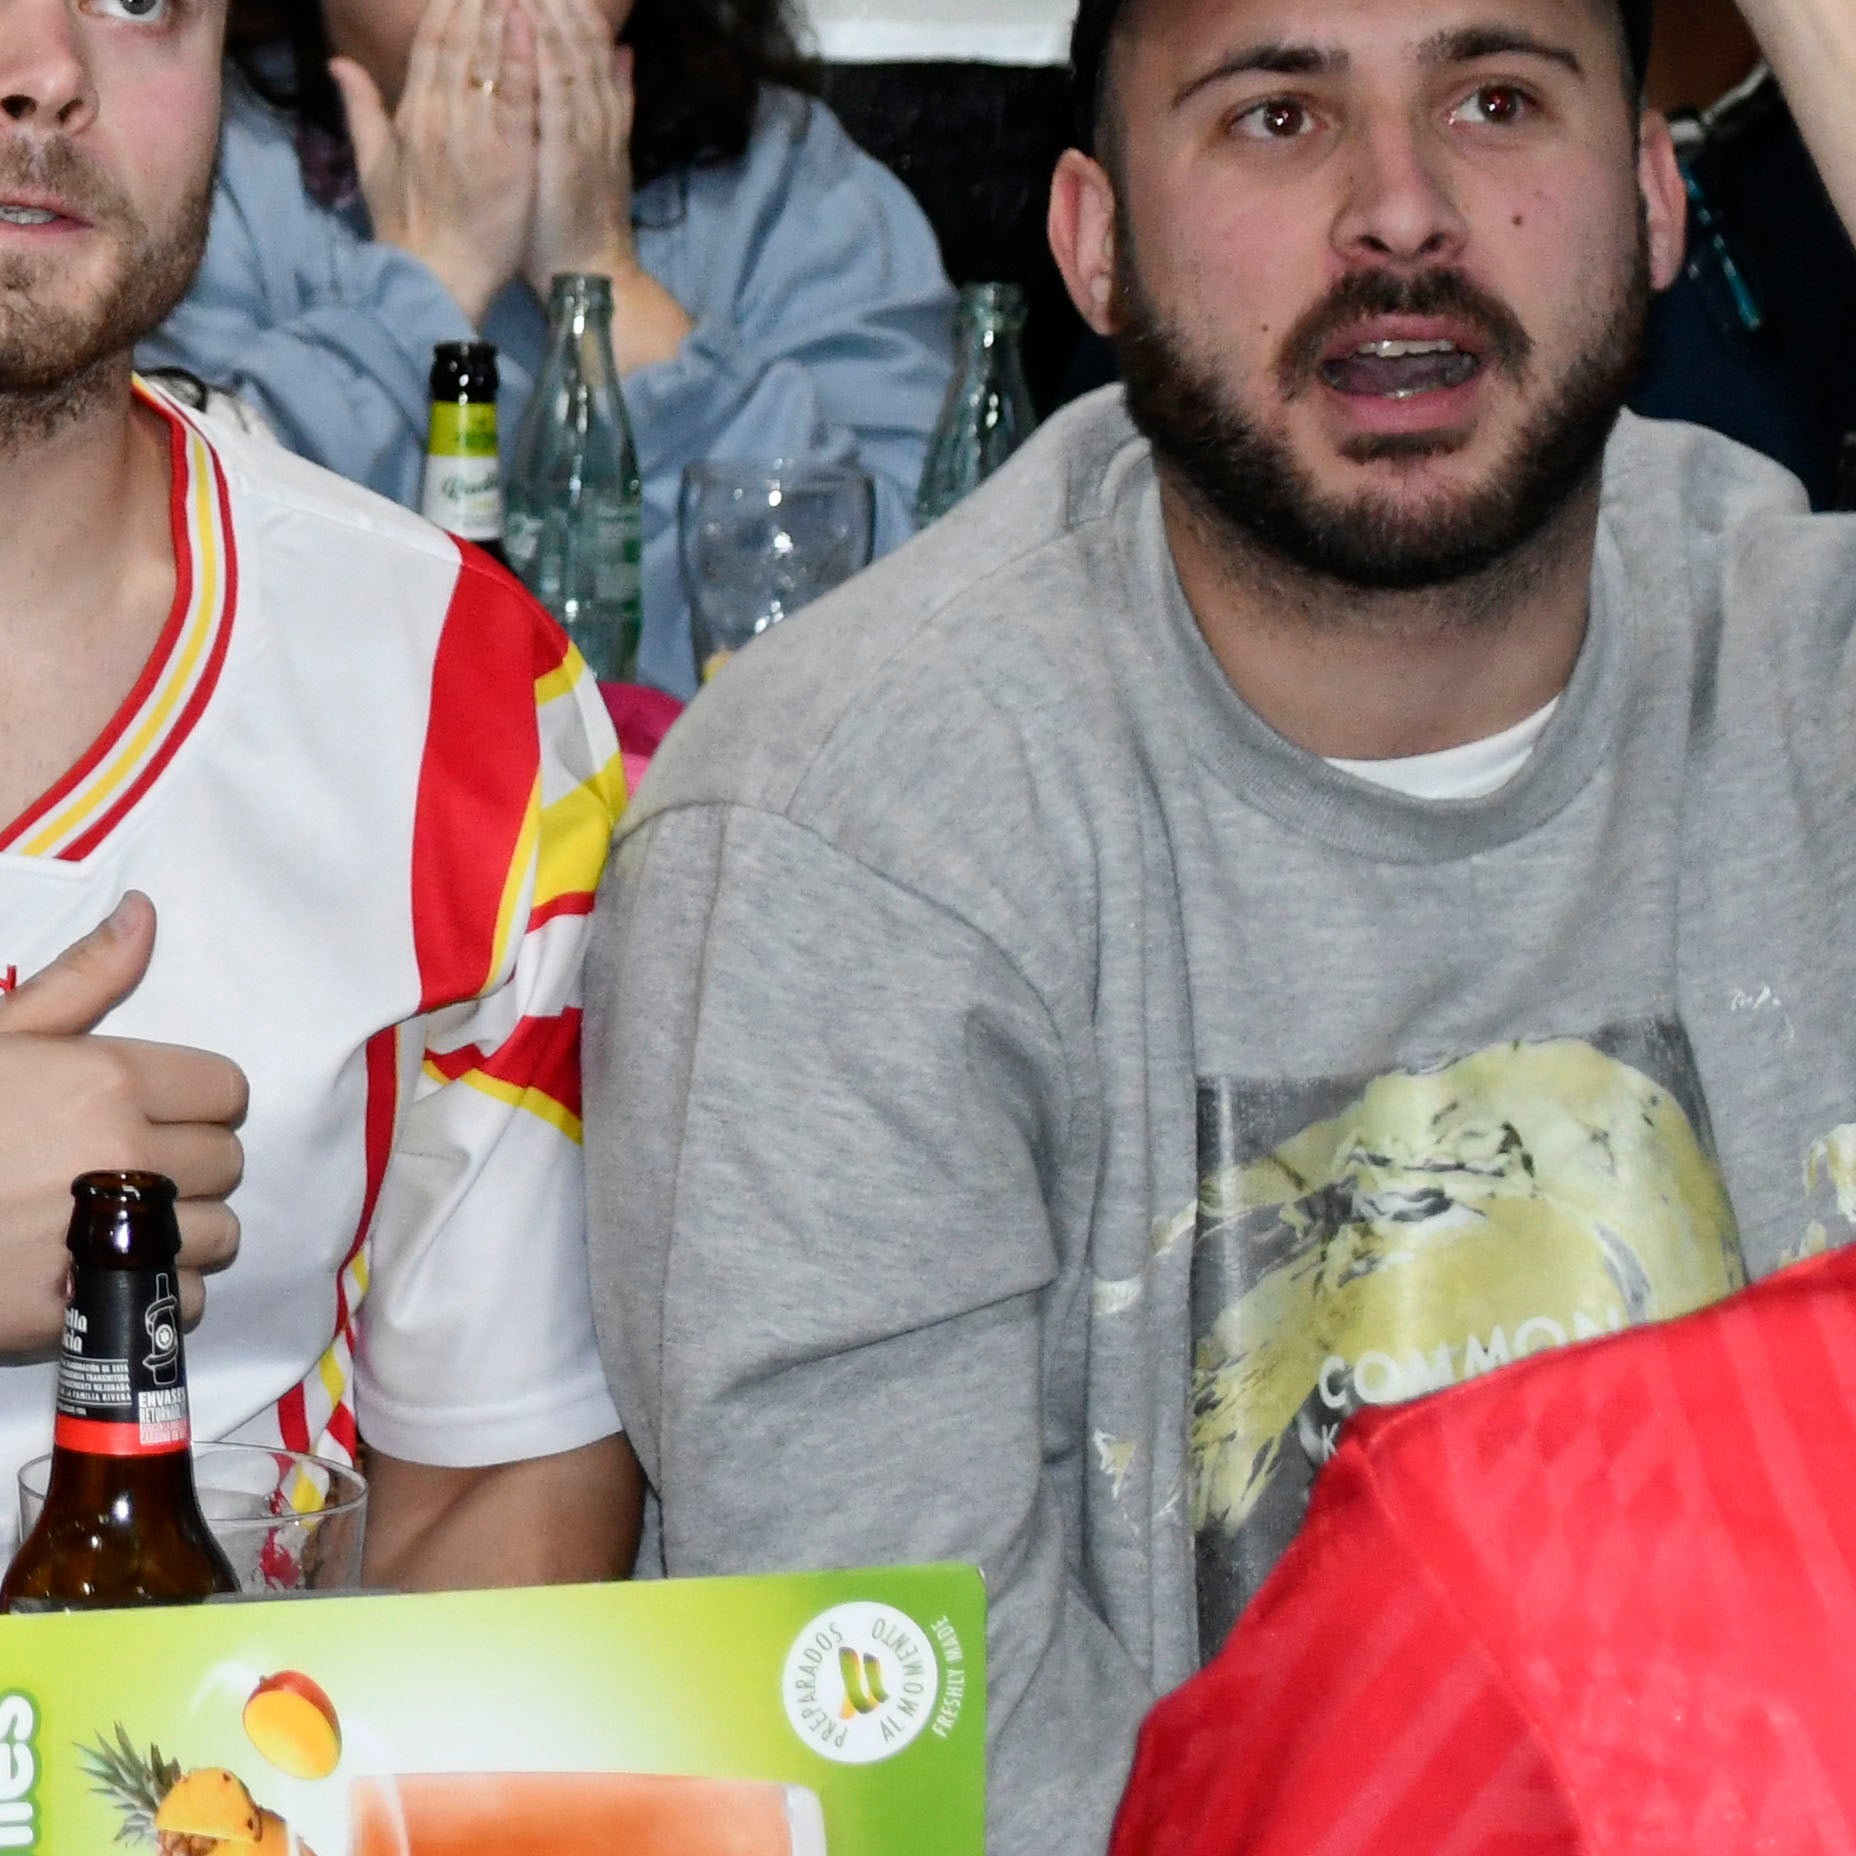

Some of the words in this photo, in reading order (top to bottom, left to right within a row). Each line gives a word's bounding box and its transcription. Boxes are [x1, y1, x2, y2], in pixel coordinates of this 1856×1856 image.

[872, 1617, 925, 1718] MOMENTO
[930, 1615, 964, 1663] MADE
[794, 1621, 848, 1749] PREPARADOS
[931, 1668, 966, 1739] FRESHLY
